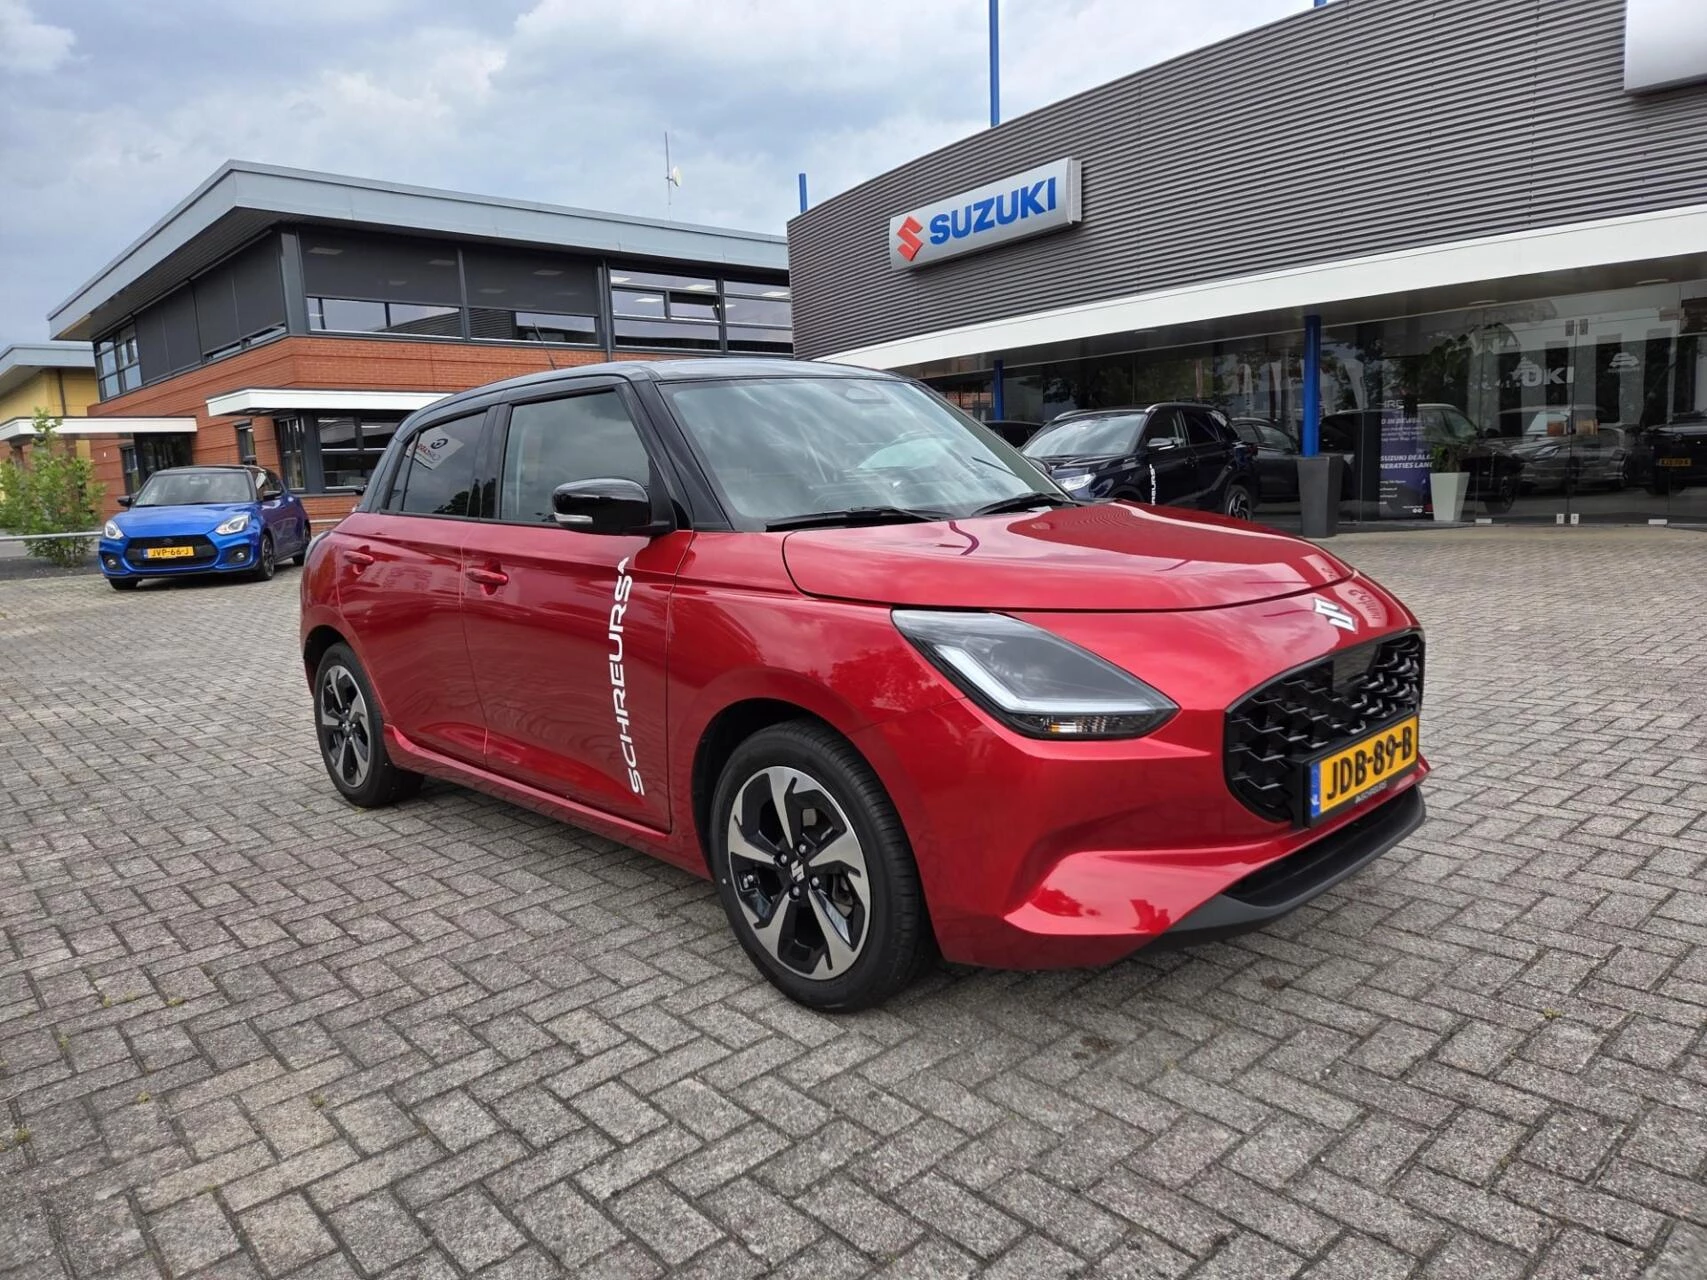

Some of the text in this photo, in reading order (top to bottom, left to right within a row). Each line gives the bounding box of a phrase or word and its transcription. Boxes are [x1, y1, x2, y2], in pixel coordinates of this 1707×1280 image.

[929, 176, 1056, 245] SUZUKI
[608, 574, 645, 796] SCHREURS
[1327, 726, 1412, 800] JDB-89-B
